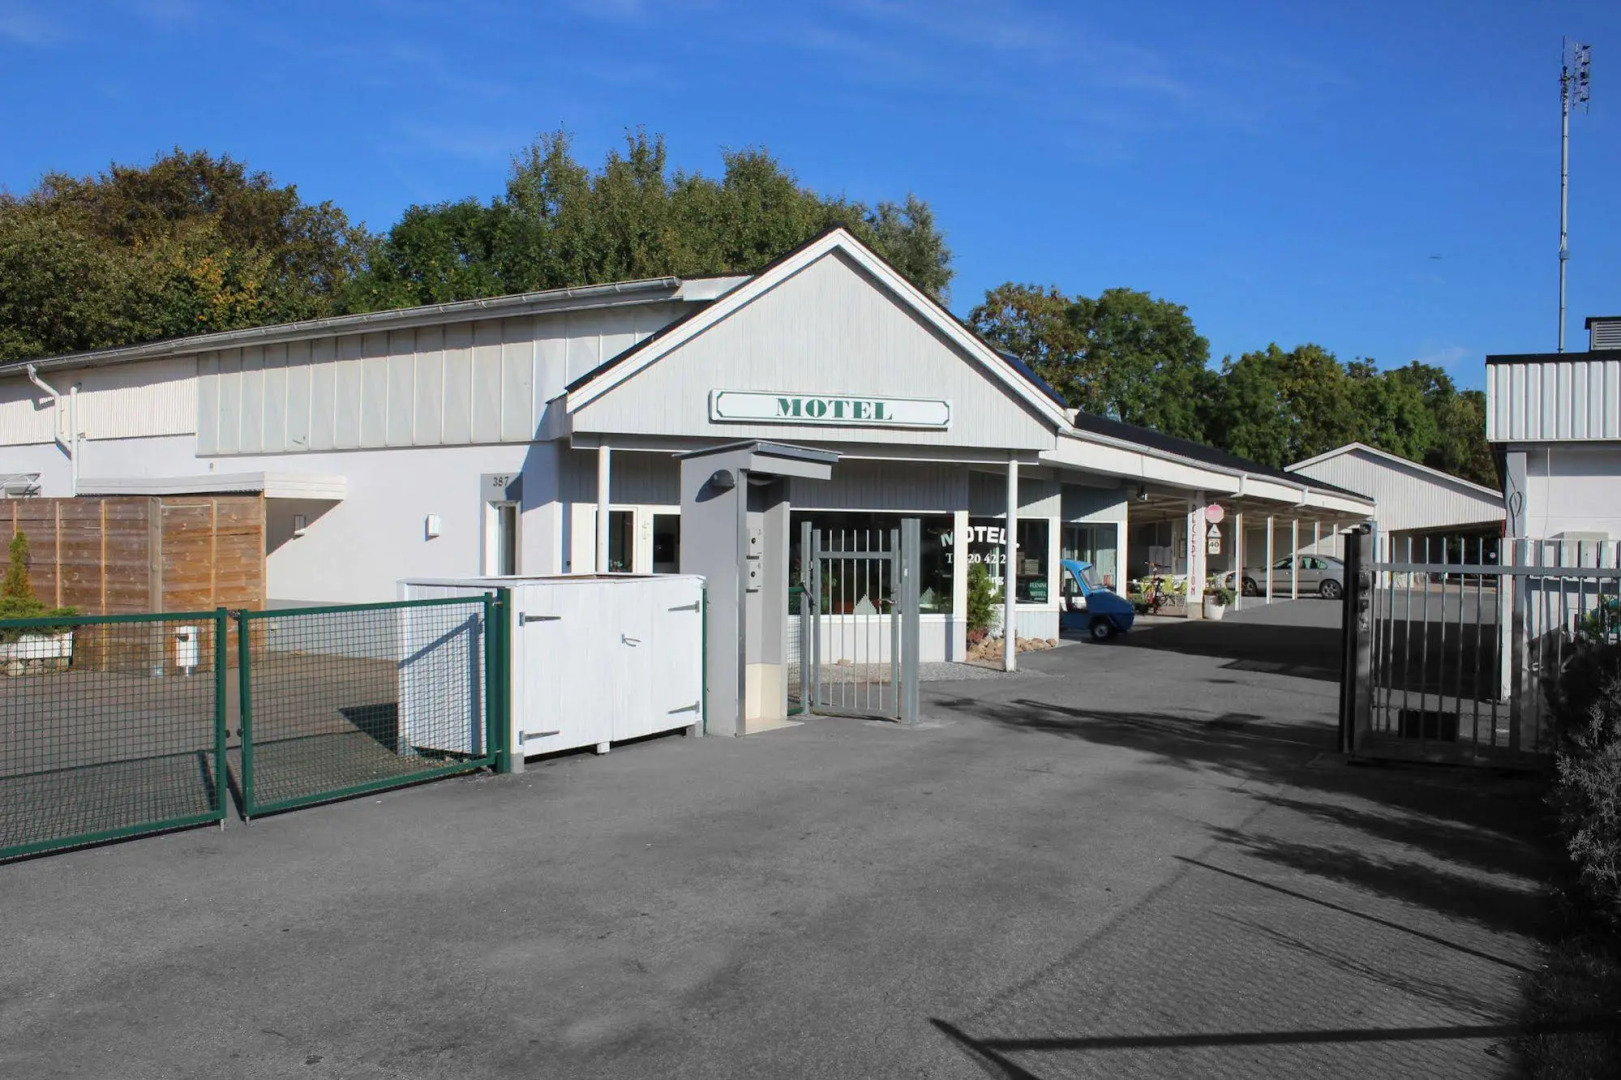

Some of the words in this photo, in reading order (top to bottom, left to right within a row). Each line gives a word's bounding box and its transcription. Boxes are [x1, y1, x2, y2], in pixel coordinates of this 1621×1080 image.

[776, 398, 893, 420] MOTEL
[493, 476, 509, 487] 387
[940, 526, 1020, 548] MOTEL
